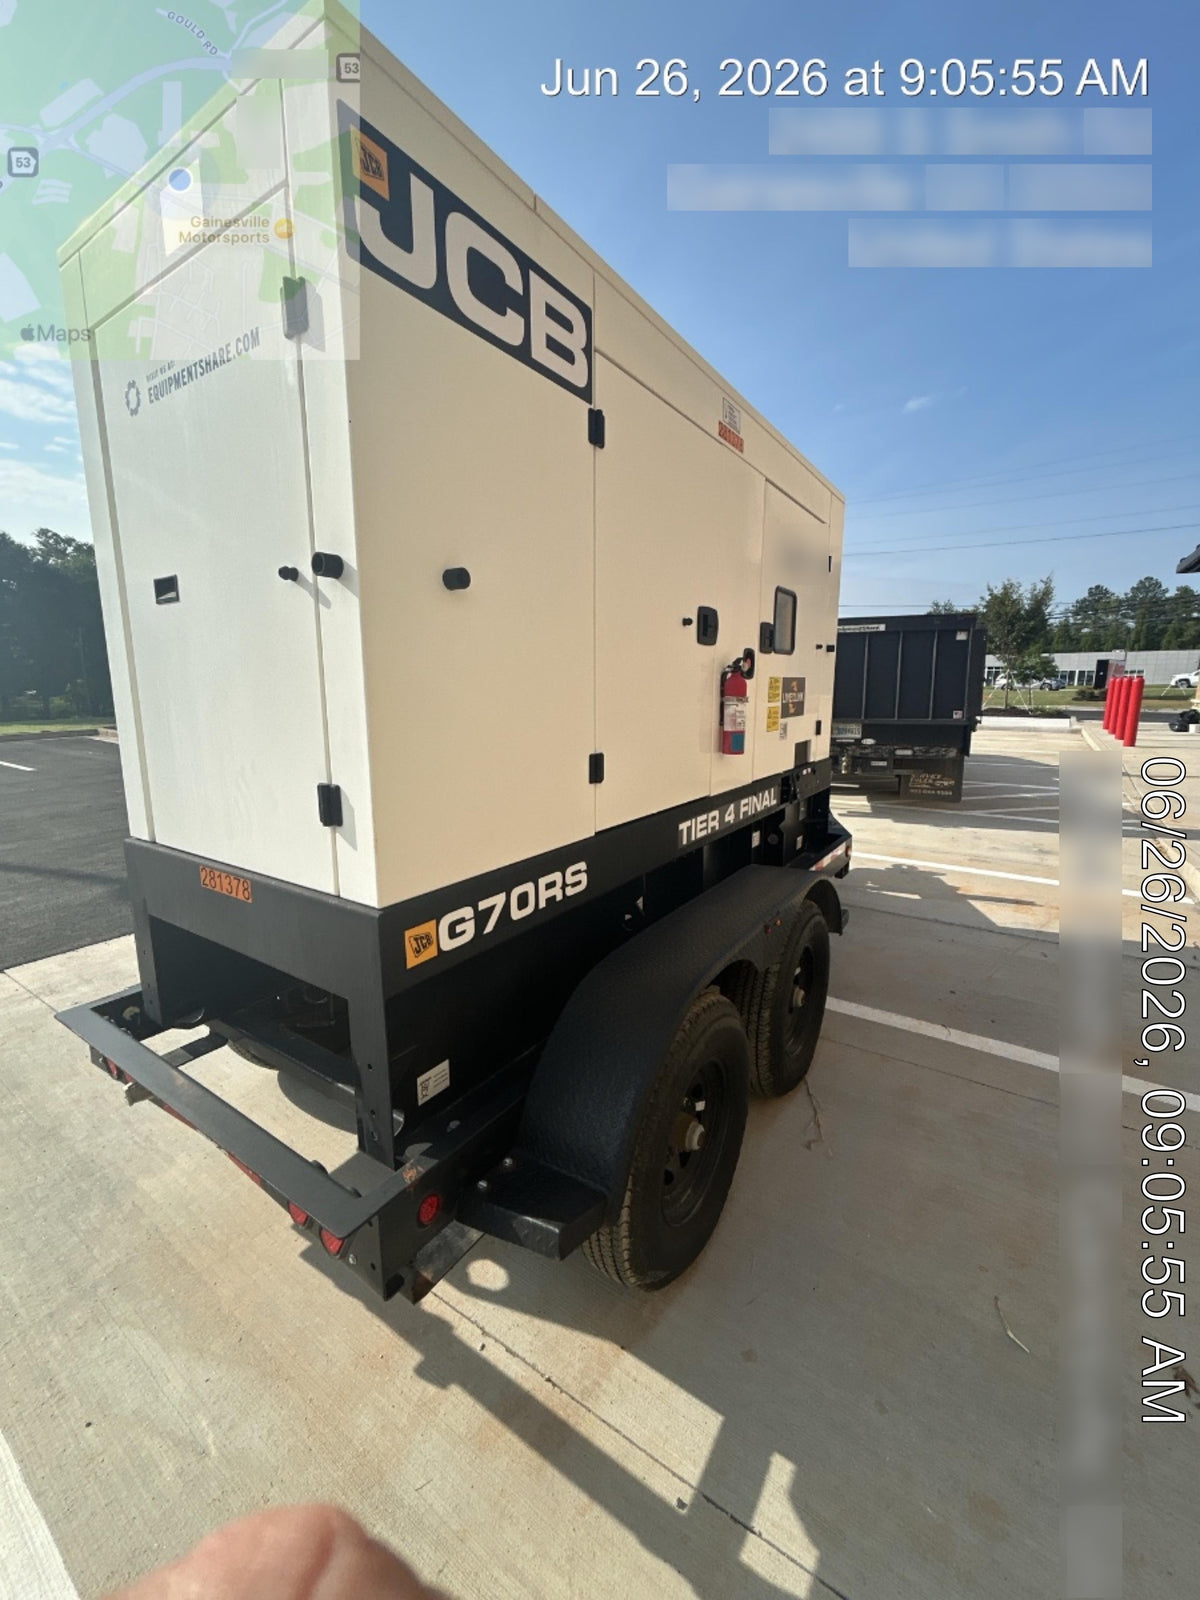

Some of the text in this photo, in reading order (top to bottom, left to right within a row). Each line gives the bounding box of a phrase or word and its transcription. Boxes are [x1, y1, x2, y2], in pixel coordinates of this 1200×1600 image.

[353, 171, 589, 389] JCB
[147, 326, 260, 404] EQUIPMENTSHARE.COM
[678, 809, 719, 845] TIER
[724, 802, 736, 824] 4
[739, 787, 777, 820] FINAL
[200, 867, 251, 901] 281378
[413, 860, 589, 954] JCB G70RS
